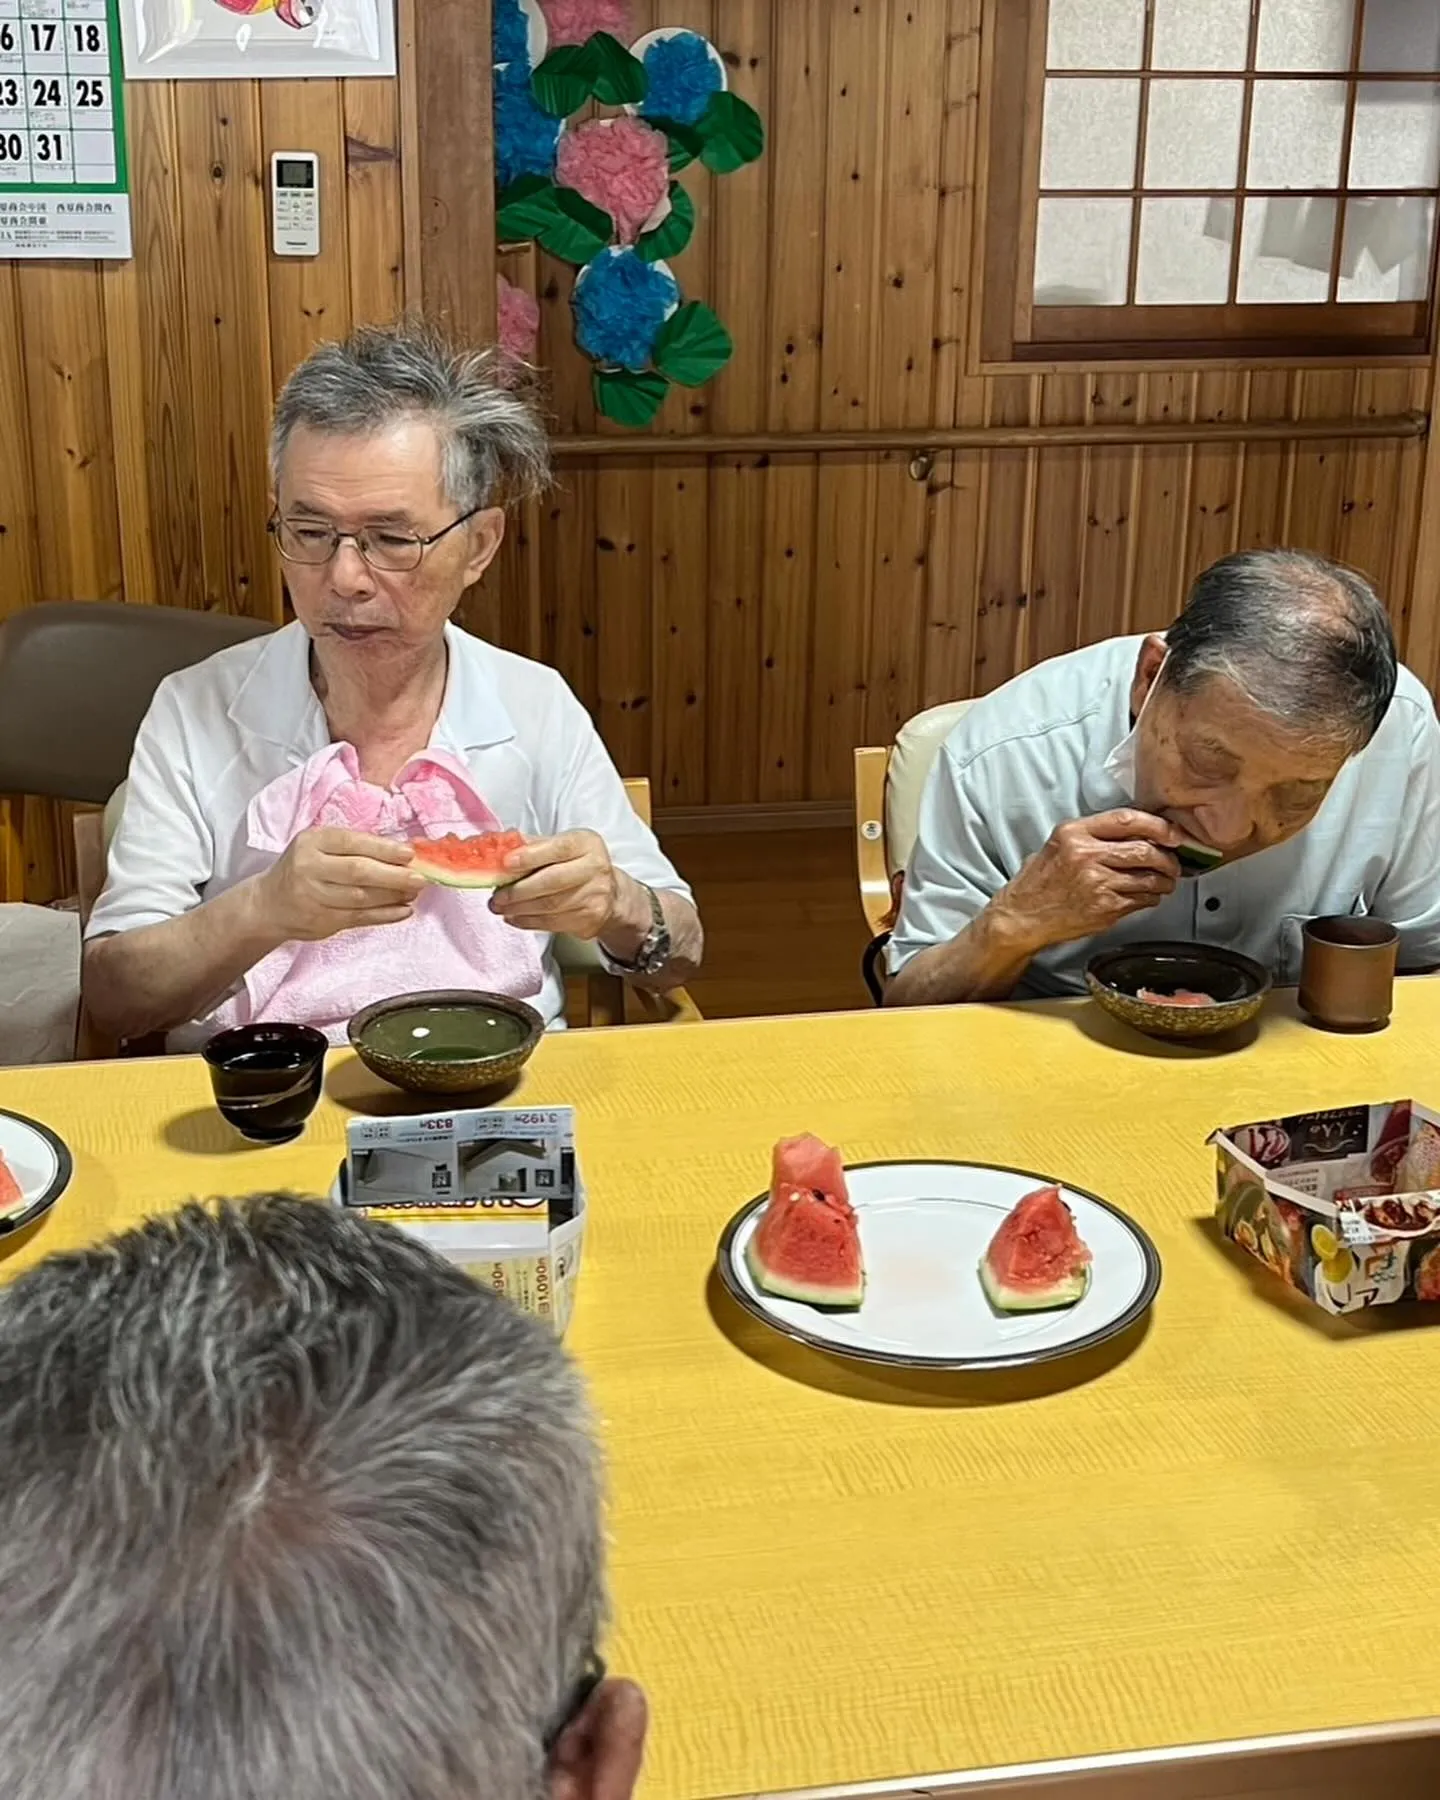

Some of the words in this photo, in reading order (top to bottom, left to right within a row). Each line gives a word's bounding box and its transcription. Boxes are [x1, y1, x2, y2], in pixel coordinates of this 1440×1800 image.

[31, 24, 56, 51] 17
[74, 25, 100, 52] 18
[0, 79, 18, 106] 3
[33, 79, 61, 106] 24
[76, 80, 104, 107] 25
[37, 134, 62, 161] 31
